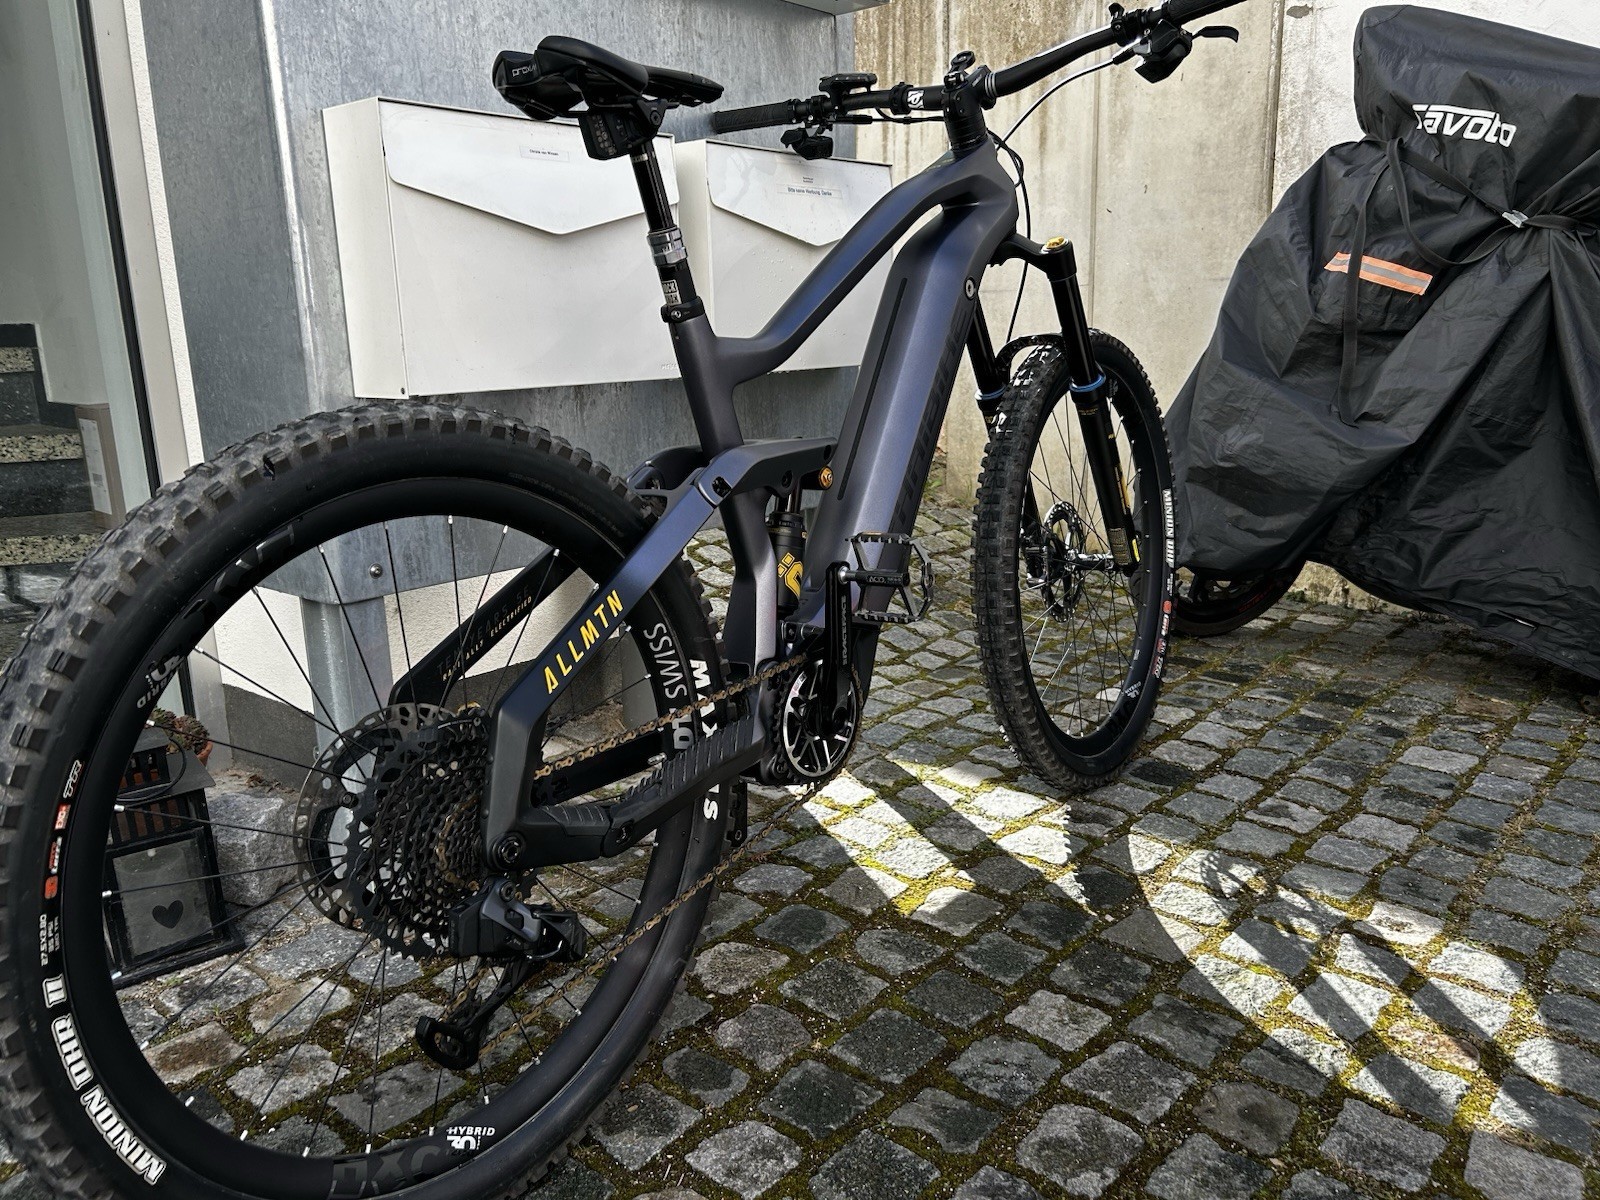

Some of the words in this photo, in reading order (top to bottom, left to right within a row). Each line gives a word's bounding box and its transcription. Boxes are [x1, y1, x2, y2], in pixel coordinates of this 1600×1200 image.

[1162, 489, 1174, 538] MINION
[543, 589, 624, 694] ALLMTN
[643, 622, 688, 699] SWISS
[51, 1013, 94, 1091] DHR
[80, 1083, 167, 1186] MINION
[446, 1126, 495, 1136] HYBRID
